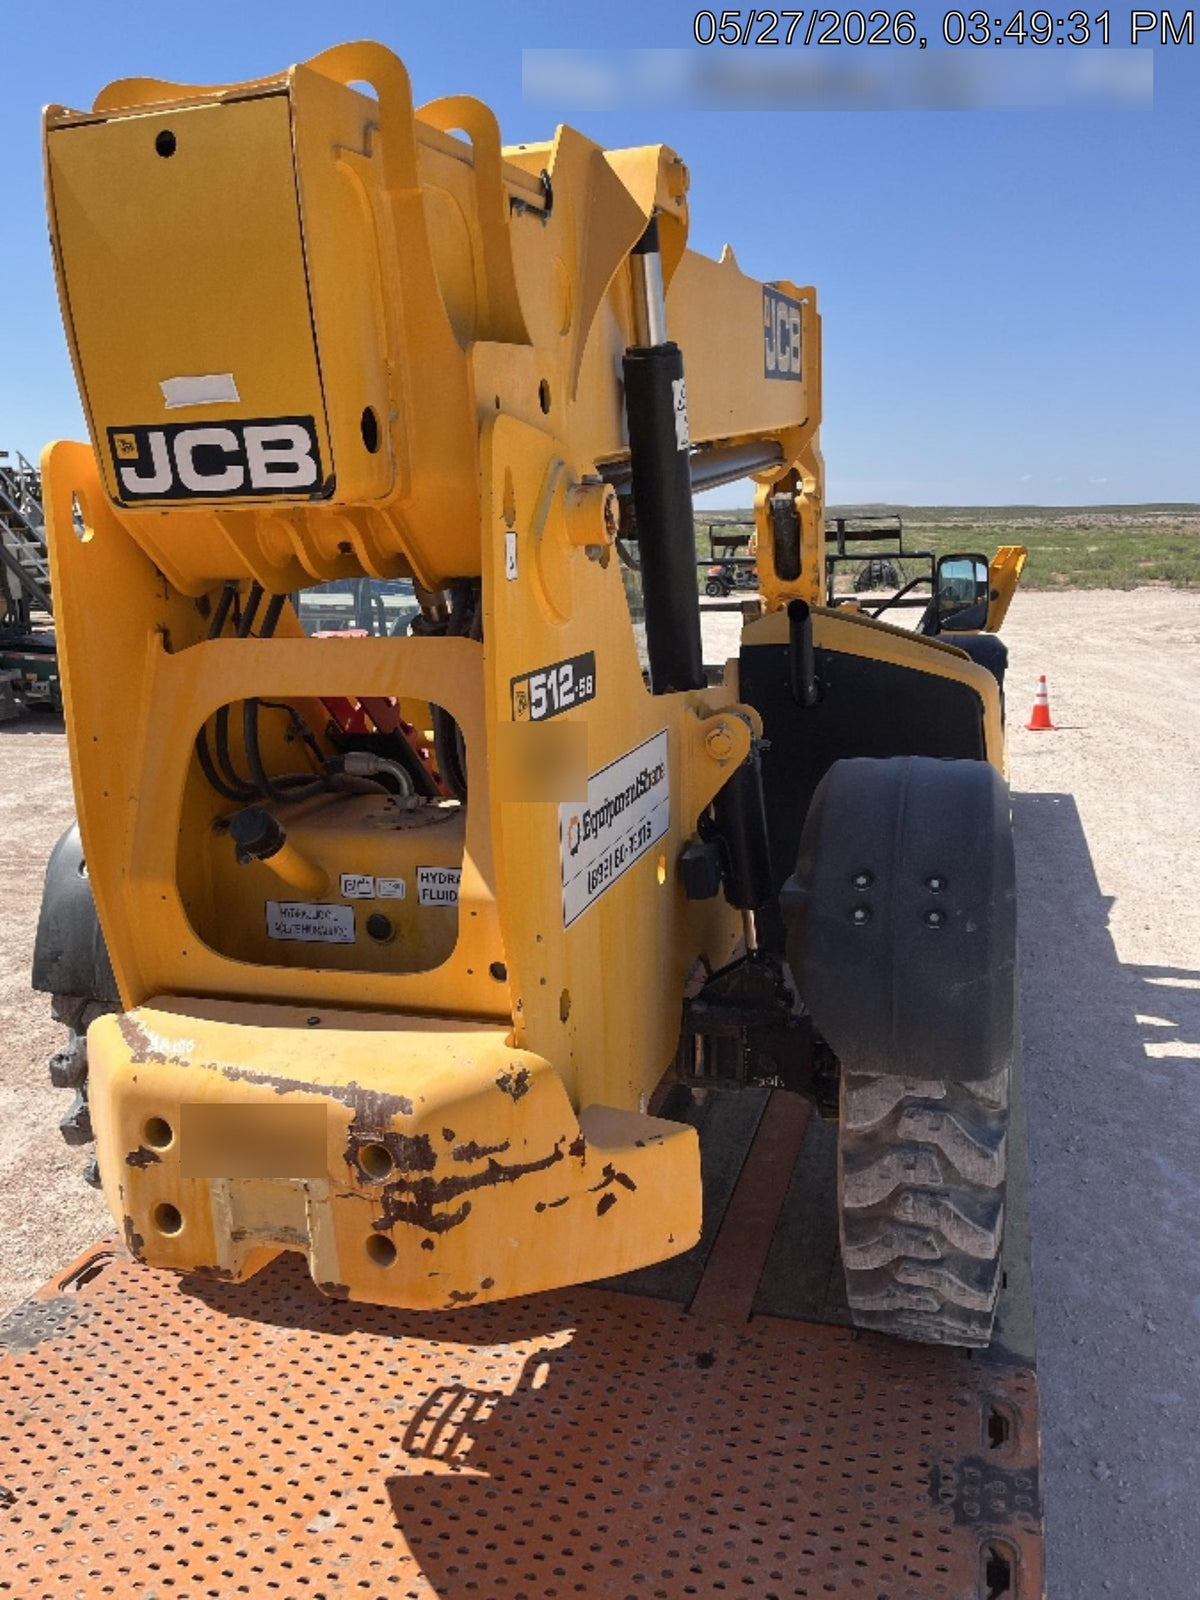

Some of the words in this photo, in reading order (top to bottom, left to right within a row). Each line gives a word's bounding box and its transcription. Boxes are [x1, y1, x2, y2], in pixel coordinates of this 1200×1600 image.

[763, 297, 801, 374] JCB
[119, 424, 318, 494] JCB
[422, 888, 458, 902] FLUID
